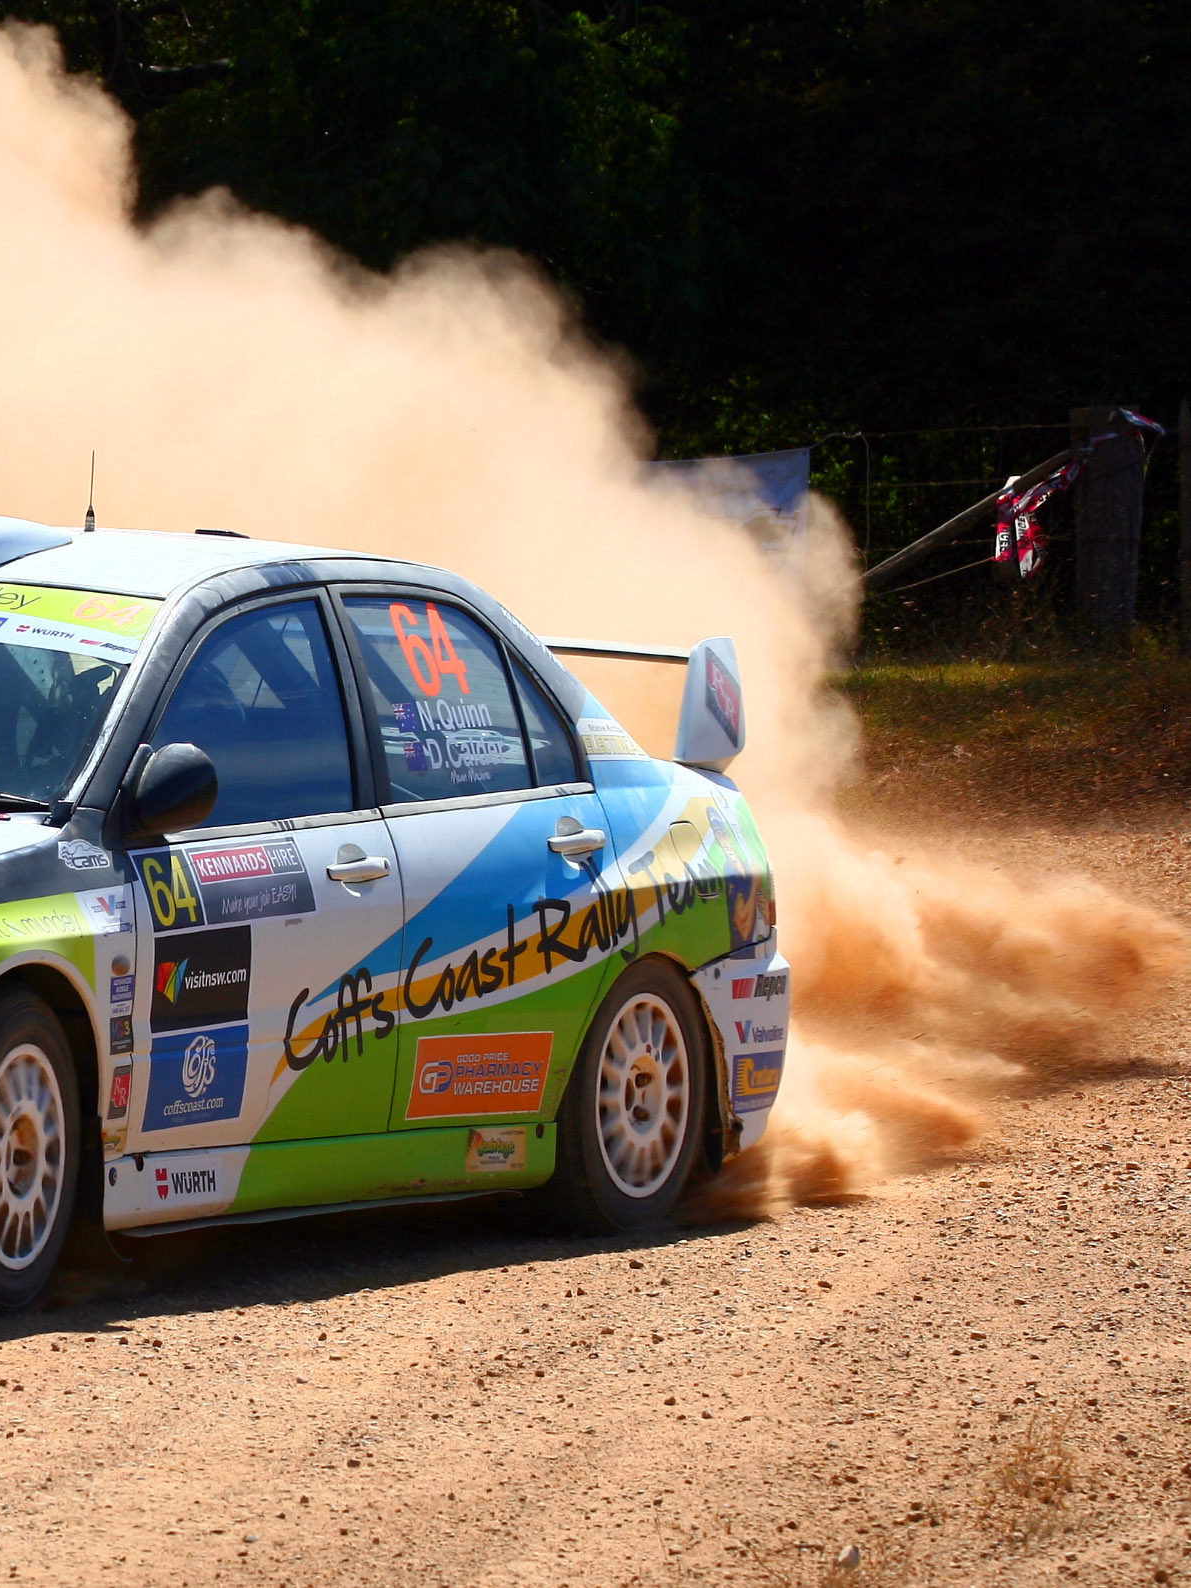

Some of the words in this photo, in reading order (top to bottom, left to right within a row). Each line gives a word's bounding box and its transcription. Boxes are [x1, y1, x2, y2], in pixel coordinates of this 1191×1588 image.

[73, 596, 146, 627] 64
[388, 601, 472, 697] 64
[415, 697, 493, 732] N.Quinn
[195, 852, 268, 877] KENNARDS
[267, 847, 299, 869] HIRE
[142, 855, 198, 928] 64
[20, 908, 84, 938] mundey
[282, 966, 396, 1072] Coffs
[403, 903, 528, 1020] Coast
[532, 856, 640, 975] Rally
[627, 850, 725, 927] Team
[184, 968, 247, 990] visitnsw.com
[754, 973, 788, 1001] Repco
[751, 1025, 785, 1044] Valvoline
[455, 1061, 545, 1078] PHARMACY
[456, 1053, 481, 1063] GOOD
[482, 1052, 510, 1062] PRICE
[453, 1078, 541, 1096] WAREHOUSE
[163, 1097, 225, 1116] coffscoast.com
[171, 1169, 217, 1194] WÜRTH
